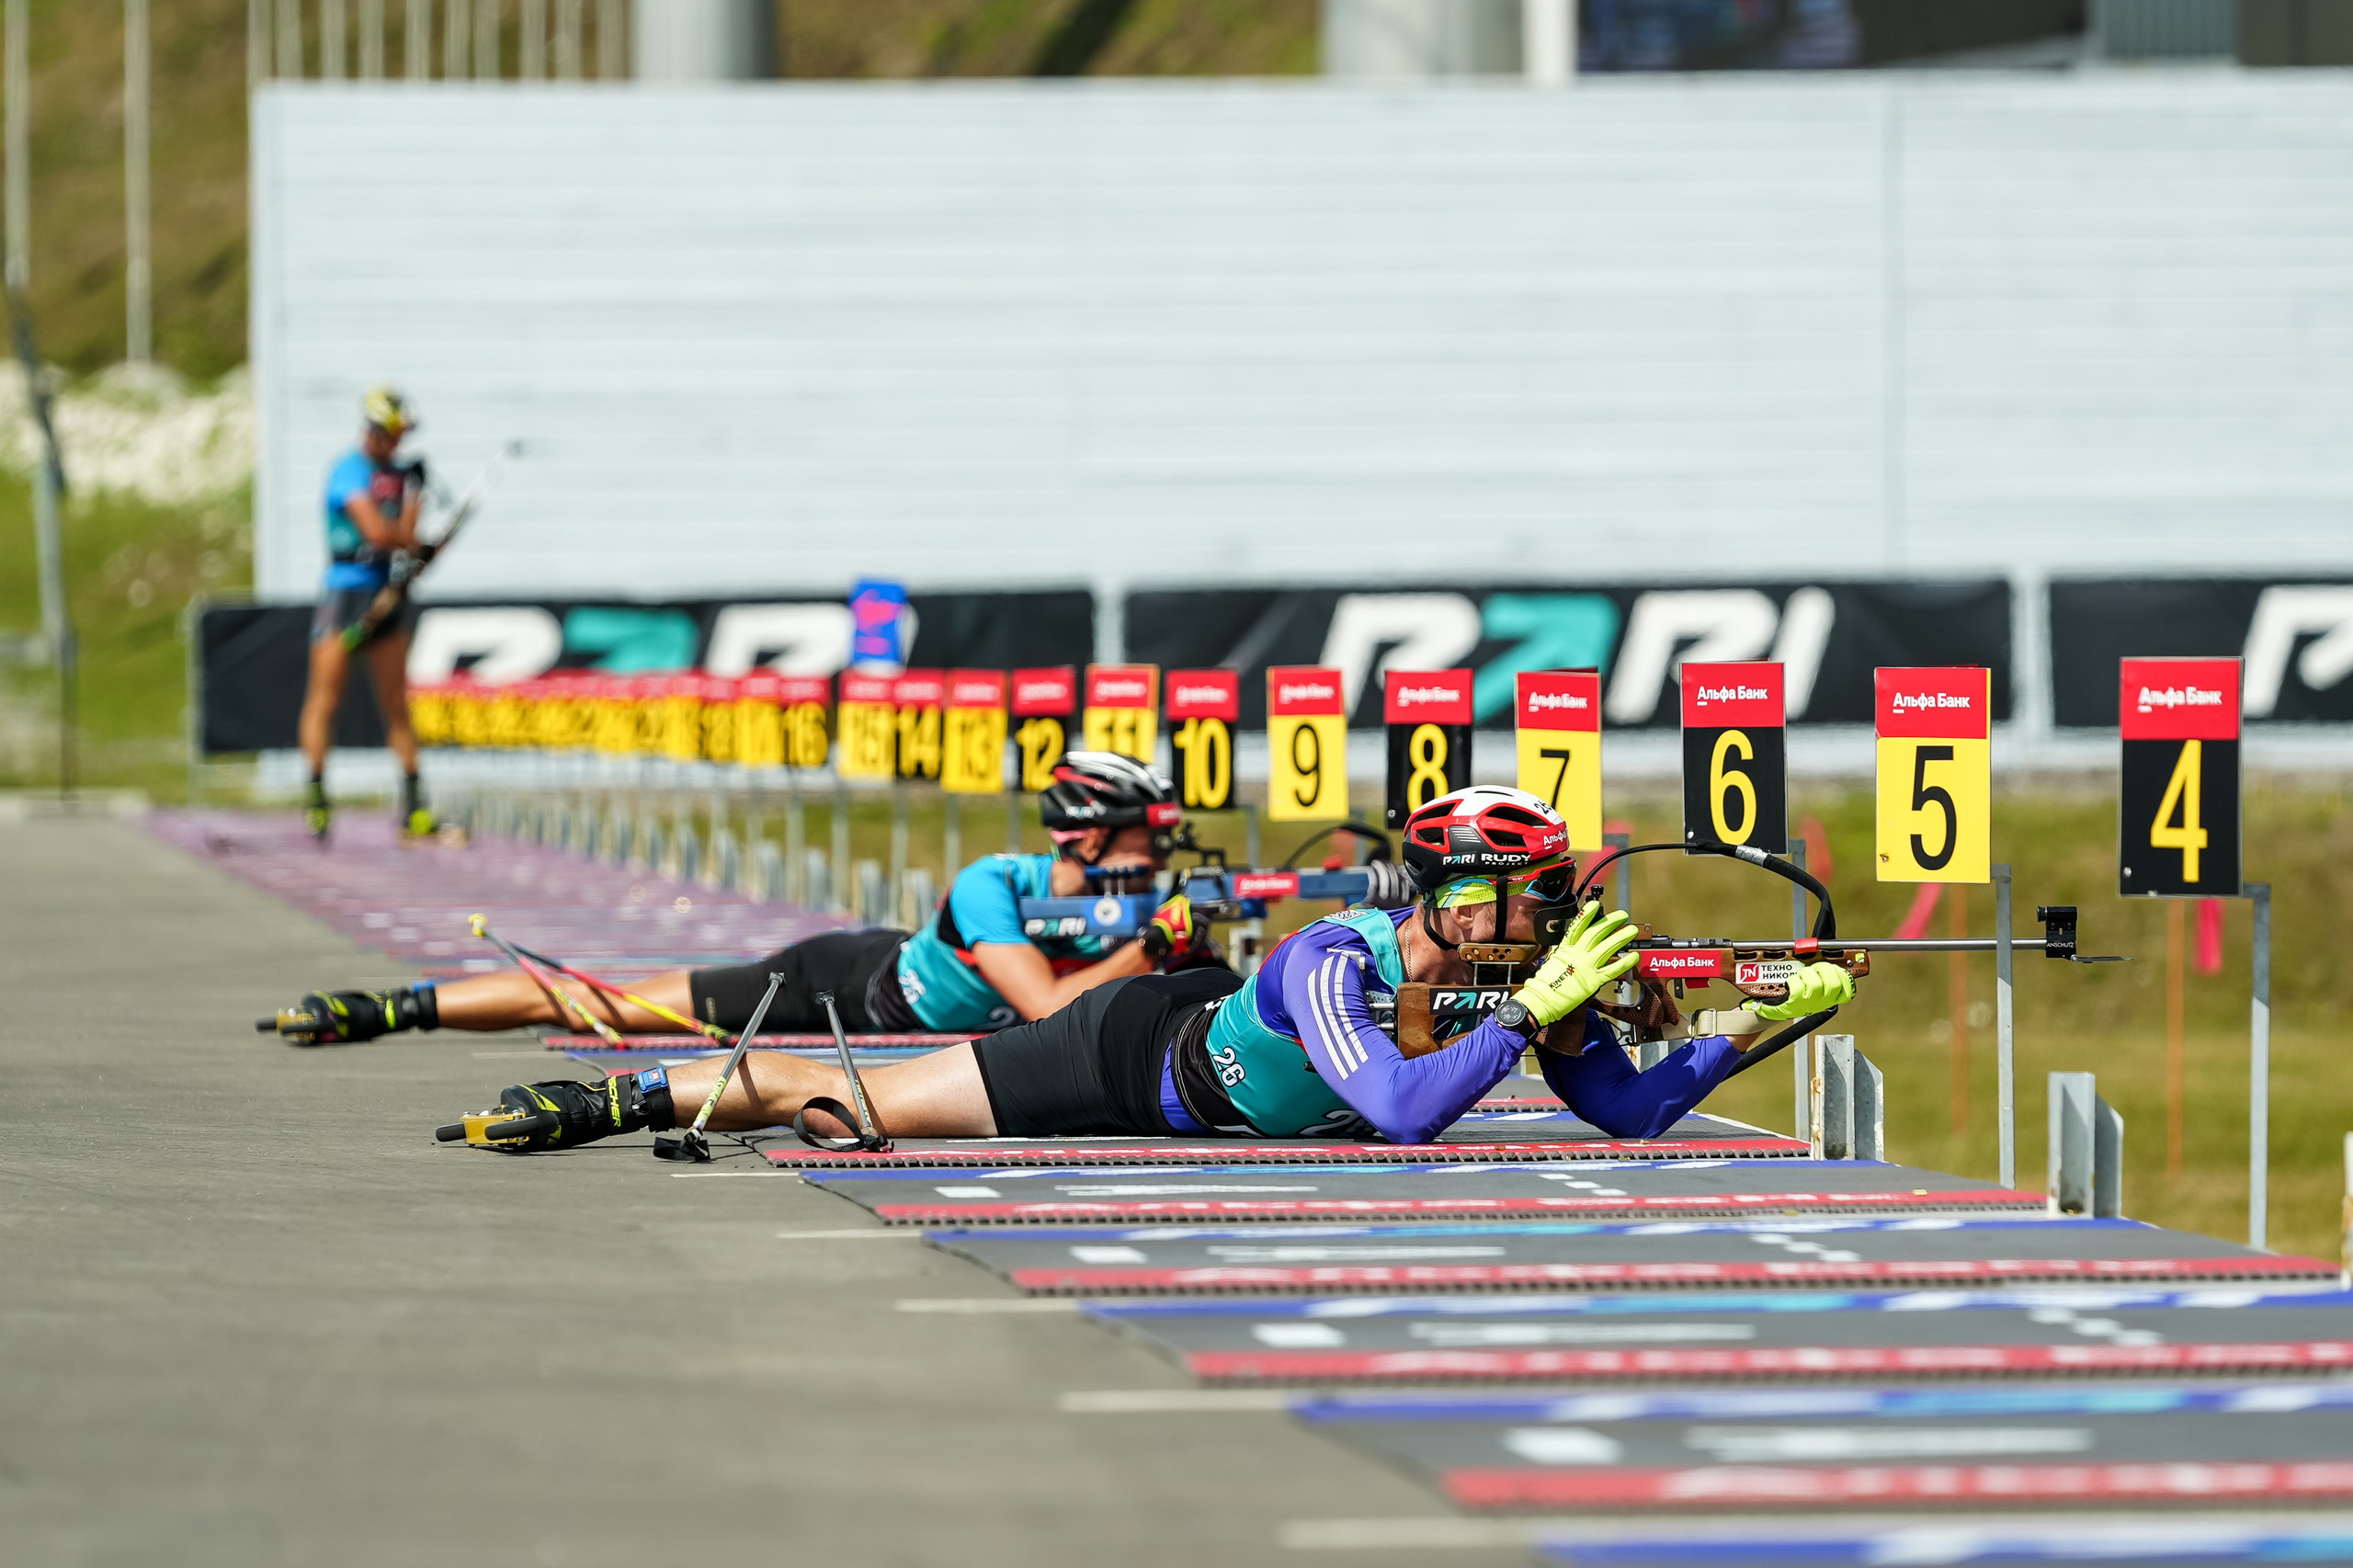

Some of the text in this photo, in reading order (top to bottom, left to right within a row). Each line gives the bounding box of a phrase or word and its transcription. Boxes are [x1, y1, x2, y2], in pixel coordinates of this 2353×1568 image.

[1528, 691, 1588, 710] Альфа Банк
[1697, 685, 1768, 702] Альфа Банк
[1893, 691, 1972, 710] Альфа Банк
[2138, 686, 2222, 708] Альфа Банк
[896, 703, 942, 780] 14
[1016, 717, 1066, 792] 12
[1174, 717, 1231, 809] 10
[1292, 722, 1321, 808] 9
[1407, 723, 1449, 814] 8
[1540, 748, 1570, 811] 7
[1710, 729, 1757, 846] 6
[1910, 745, 1957, 871] 5
[2150, 739, 2208, 882] 4
[1442, 853, 1475, 865] PARI
[1481, 853, 1531, 862] RUDY
[1650, 956, 1715, 968] Альфа Банк
[1762, 971, 1799, 980] НИКО
[1432, 991, 1509, 1010] PARI
[1212, 1046, 1246, 1088] 26
[607, 1075, 621, 1128] SCHER
